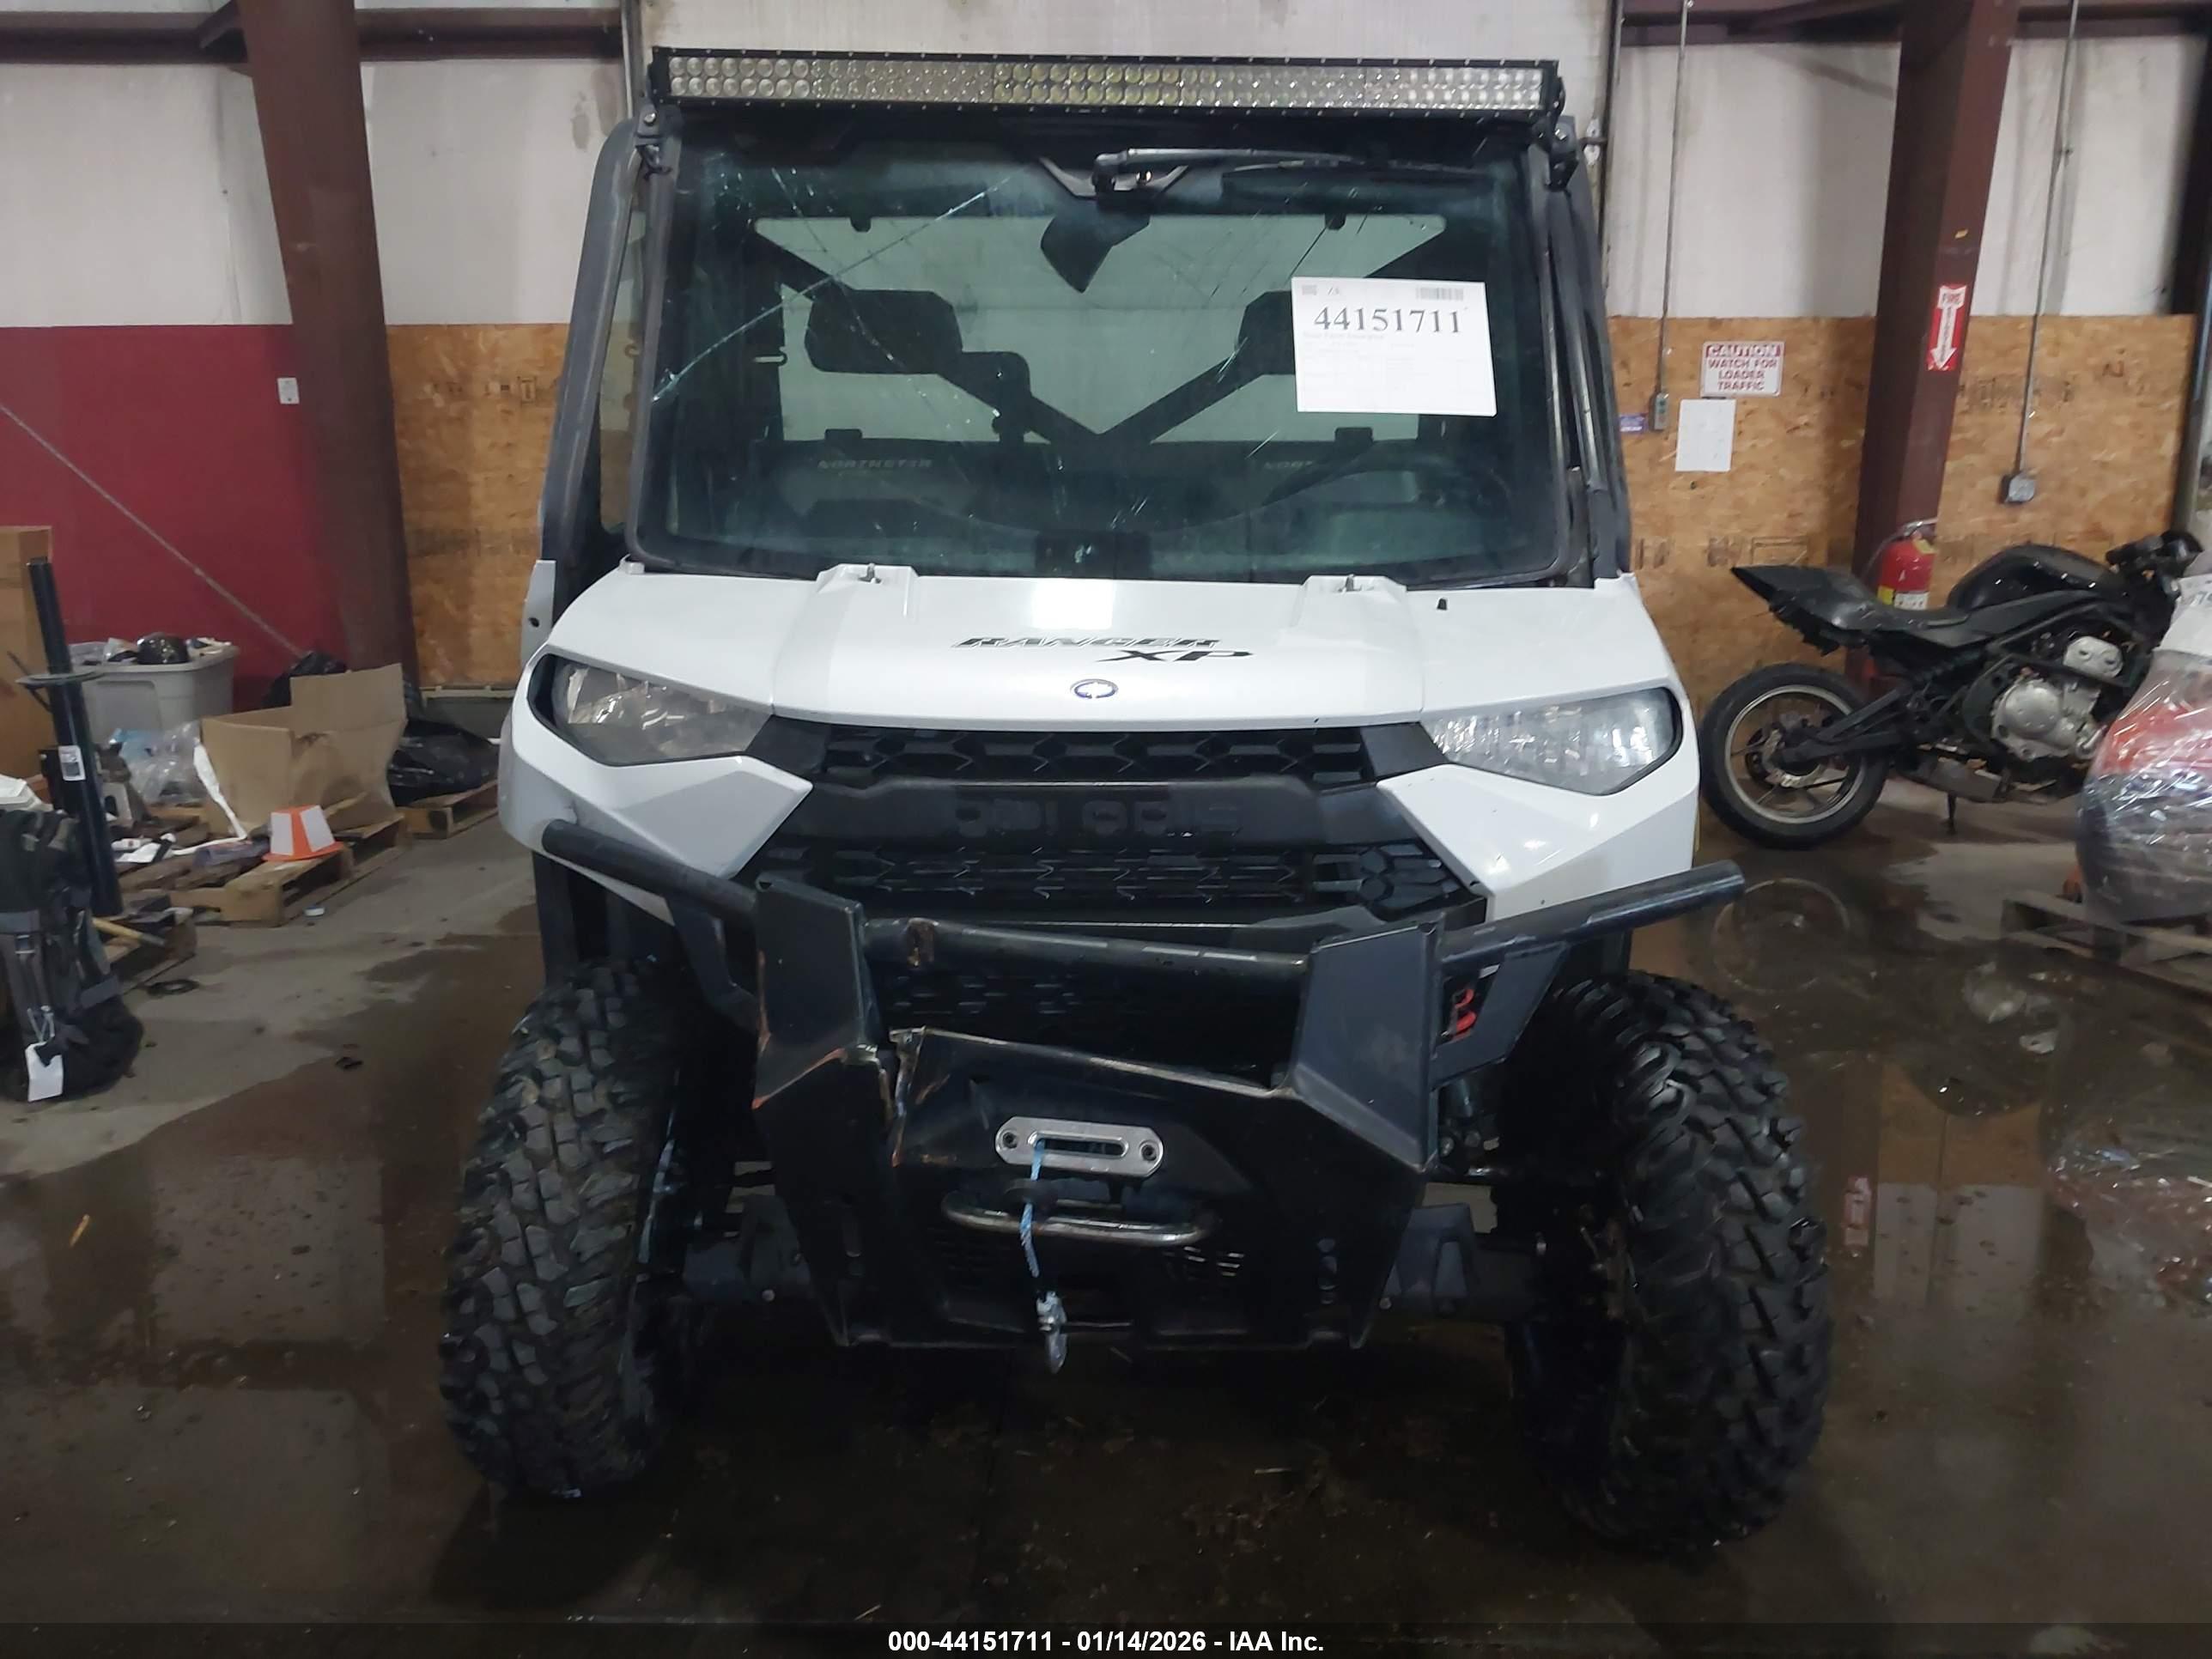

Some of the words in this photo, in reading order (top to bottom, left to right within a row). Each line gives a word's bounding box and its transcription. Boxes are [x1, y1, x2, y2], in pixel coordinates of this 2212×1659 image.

[1314, 306, 1461, 333] 44151711
[1707, 344, 1777, 357] CAUTION
[1709, 359, 1750, 369] WATCH
[1754, 359, 1777, 368] FOR
[1718, 370, 1765, 380] LOADER
[1718, 380, 1765, 392] TRAFFIC
[951, 636, 1221, 648] RANGER
[1094, 649, 1255, 662] XP
